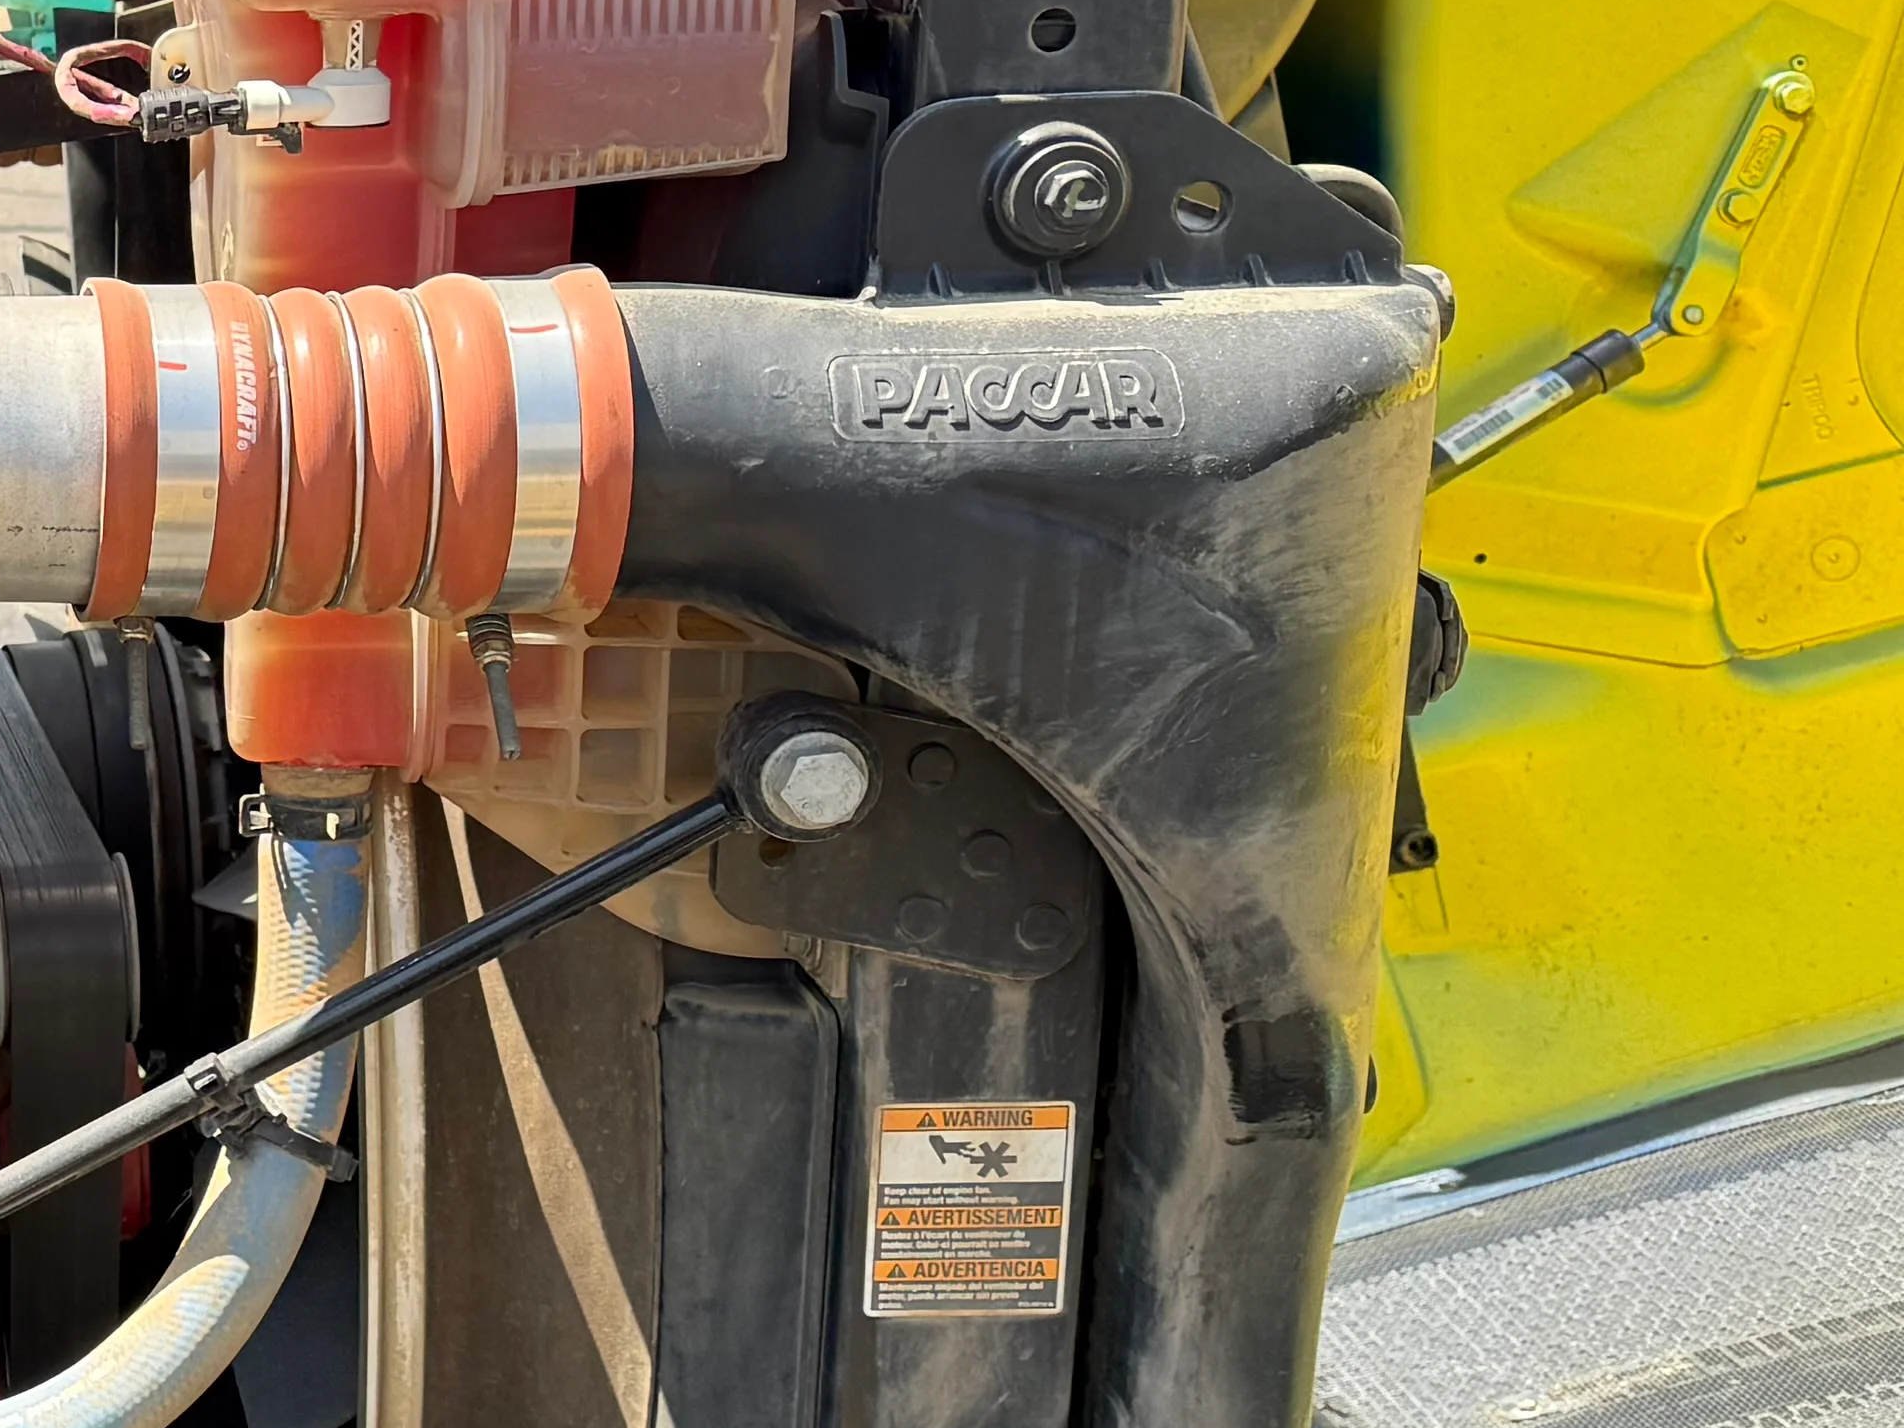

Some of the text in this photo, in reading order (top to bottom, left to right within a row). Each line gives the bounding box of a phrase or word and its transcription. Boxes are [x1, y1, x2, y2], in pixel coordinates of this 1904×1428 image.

[227, 320, 257, 441] DYNACRAFT
[851, 360, 1167, 431] PACCAR
[943, 1110, 1032, 1126] WARNING
[907, 1208, 1059, 1226] AVERTISSEMENT
[914, 1261, 1045, 1278] ADVERTENCIA
